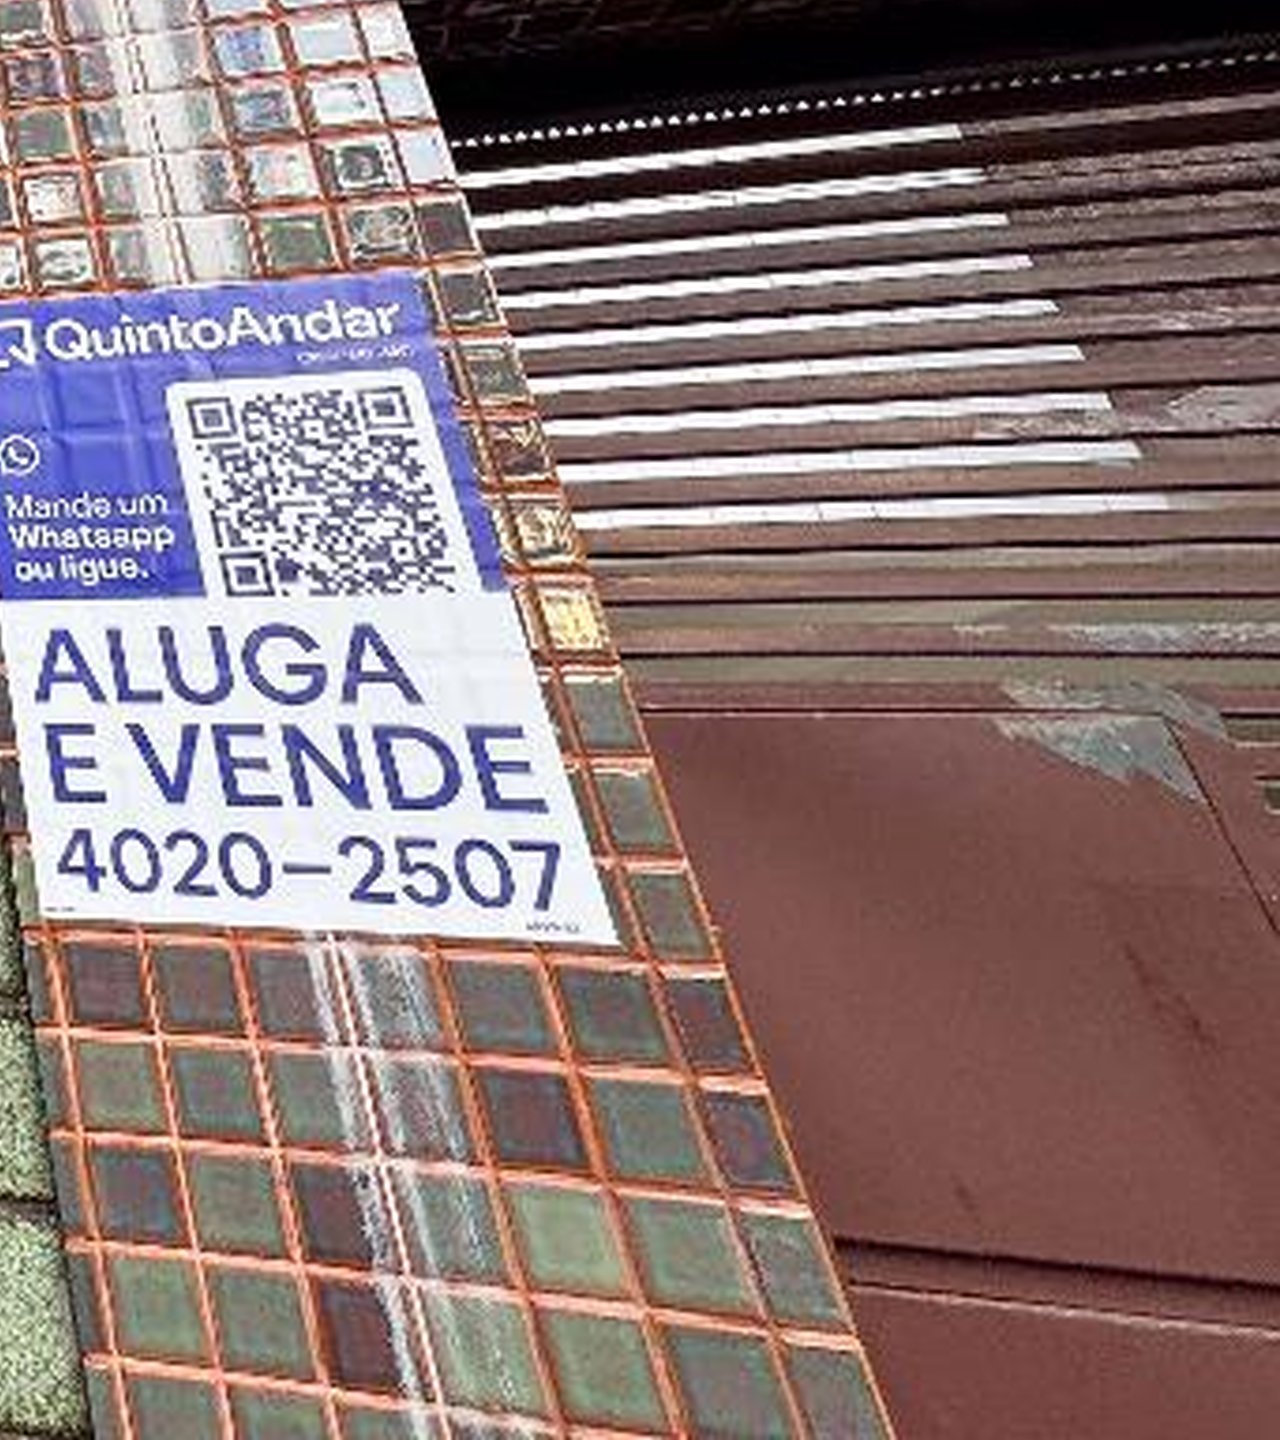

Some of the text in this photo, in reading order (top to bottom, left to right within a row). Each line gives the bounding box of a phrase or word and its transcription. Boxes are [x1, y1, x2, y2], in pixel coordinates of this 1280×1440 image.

[44, 300, 401, 360] QuintoAndar
[5, 491, 168, 518] Mande um
[8, 524, 176, 553] Whatsapp
[15, 554, 150, 587] ou ligue.
[34, 622, 425, 707] ALUGA
[42, 722, 550, 814] E VENDE
[56, 827, 561, 912] 4020-2507
